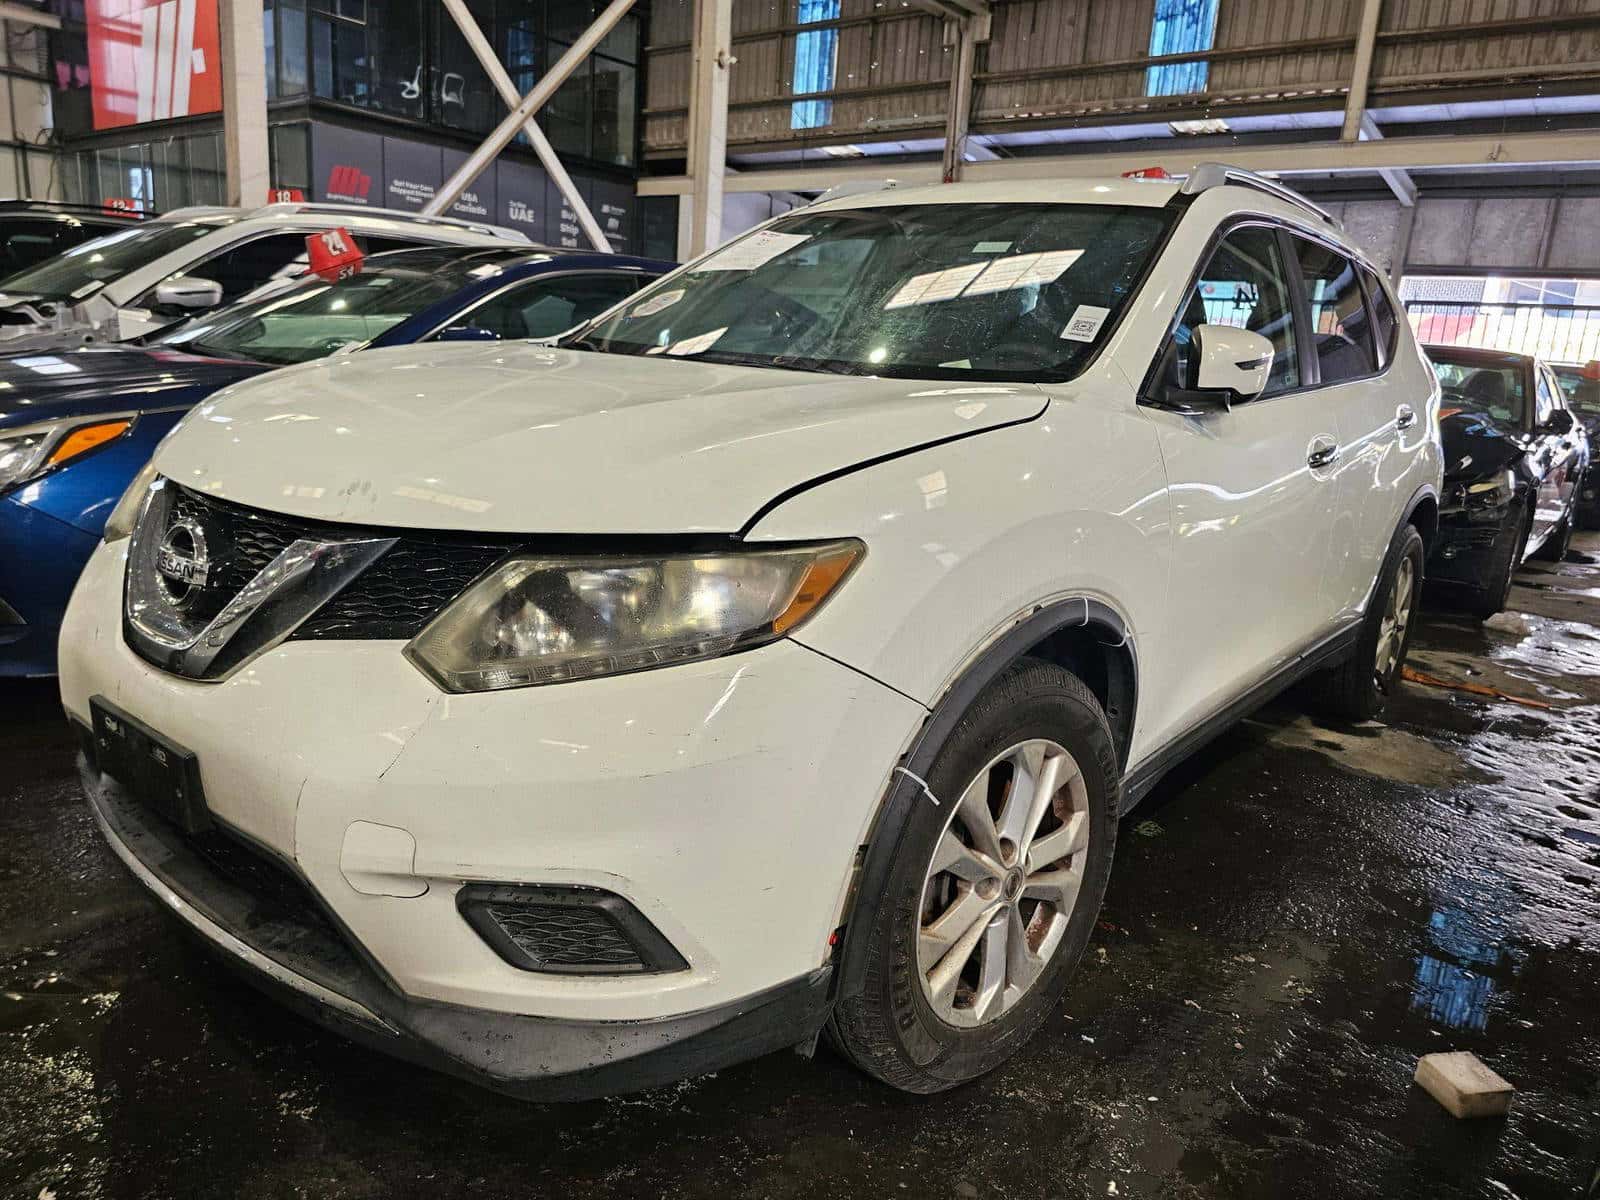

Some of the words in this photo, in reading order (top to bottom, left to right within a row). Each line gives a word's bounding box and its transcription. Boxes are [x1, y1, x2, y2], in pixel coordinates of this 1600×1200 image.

[461, 192, 478, 203] USA
[454, 202, 488, 215] Canada
[509, 207, 535, 223] UAE
[560, 223, 579, 237] Ship
[321, 231, 347, 256] 24
